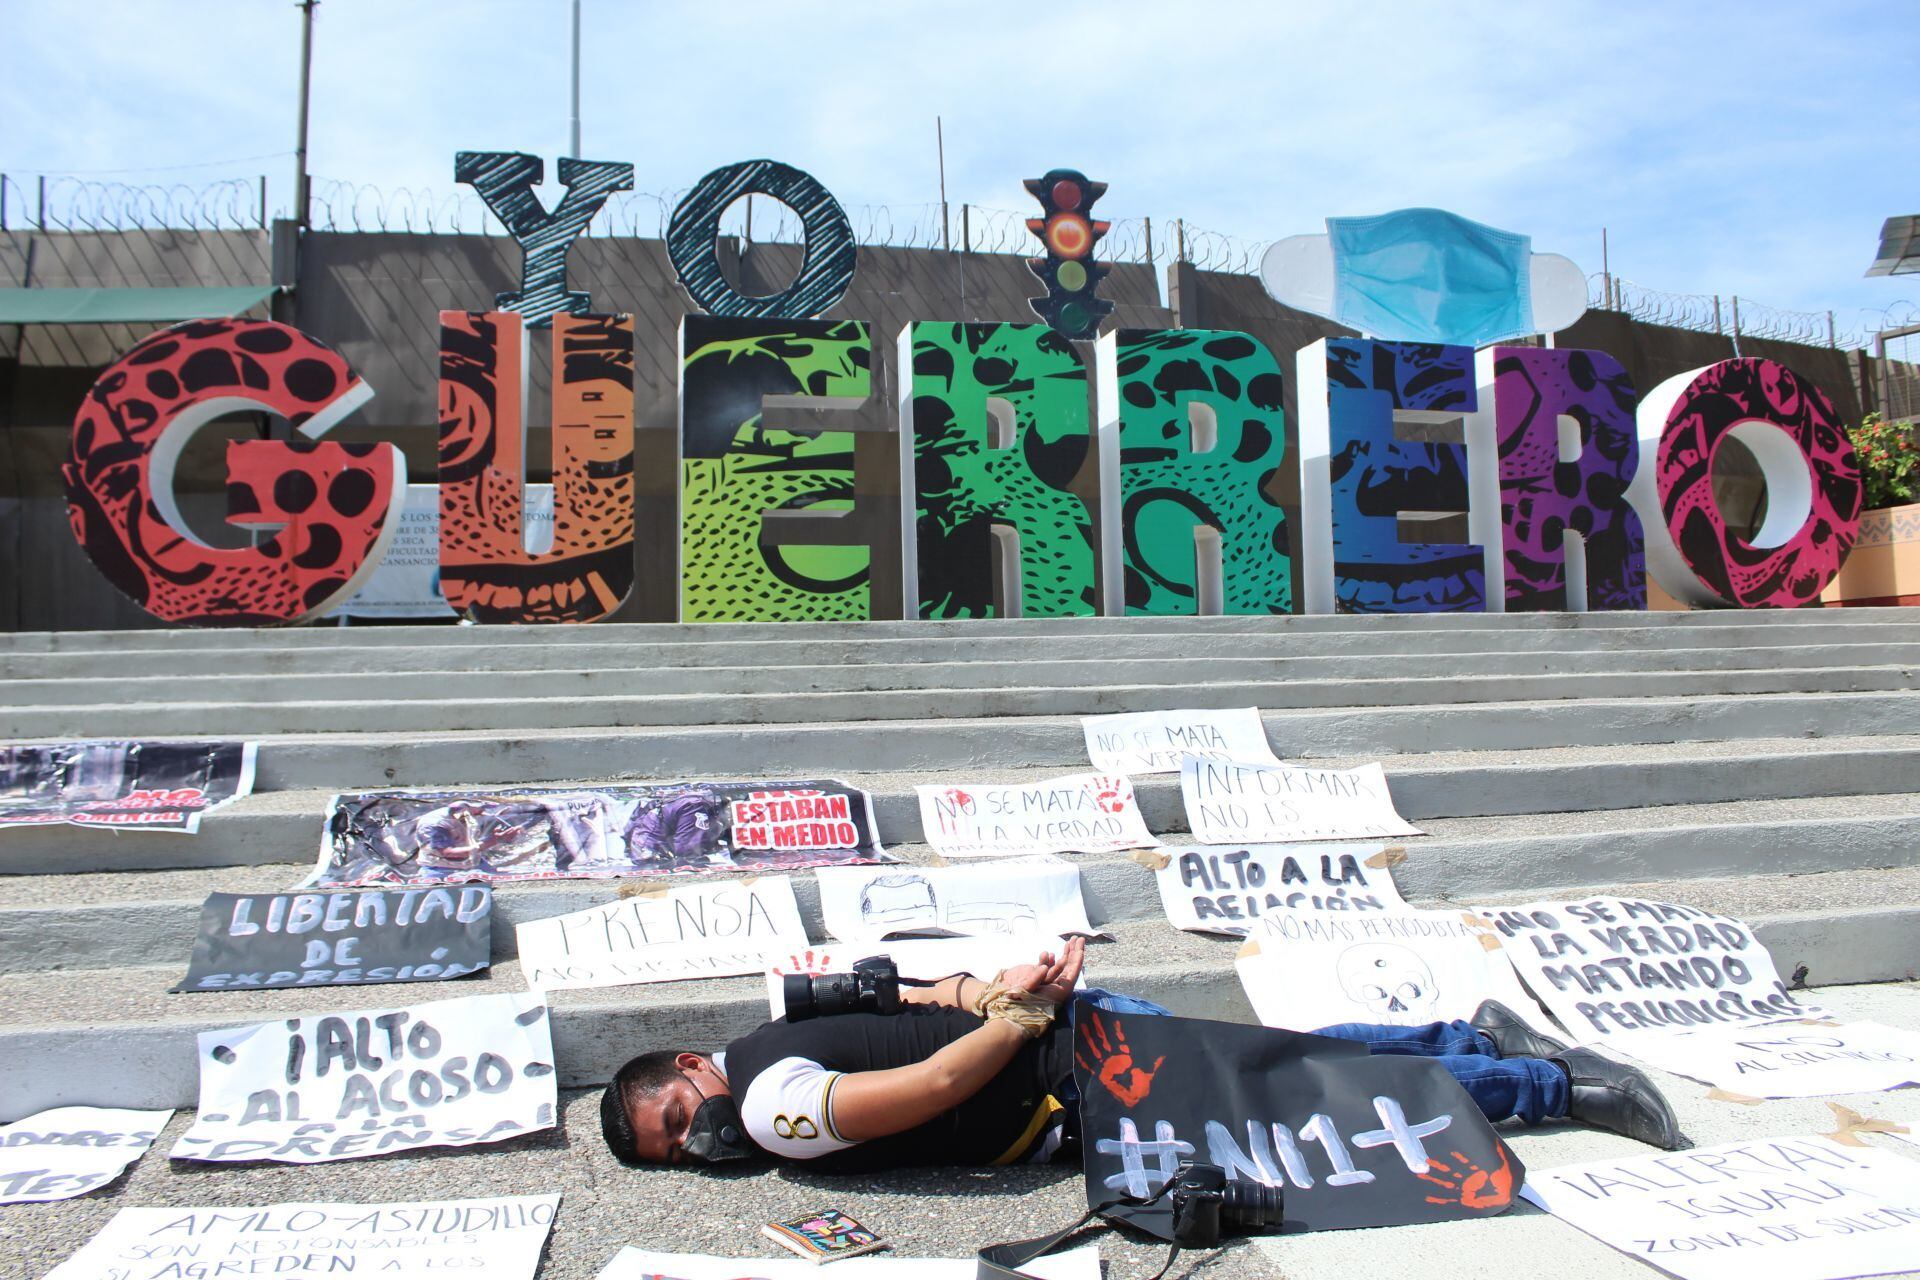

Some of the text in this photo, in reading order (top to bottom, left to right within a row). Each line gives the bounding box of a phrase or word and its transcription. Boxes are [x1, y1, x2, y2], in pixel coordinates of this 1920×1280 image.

[455, 151, 857, 328] YO
[61, 310, 1862, 628] GUERRERO
[1164, 724, 1228, 750] MATA
[1195, 761, 1377, 799] INFORMAR
[736, 796, 847, 824] ESTABAN
[935, 789, 1099, 821] NO SE MATA
[1200, 803, 1250, 828] NO
[736, 822, 857, 847] EN MEDIO
[1024, 816, 1124, 842] VERDAD
[1179, 850, 1369, 892] ALTO A LA
[228, 887, 493, 937] LIBERTAD
[559, 891, 778, 955] PRENSA
[1264, 913, 1301, 941] NO
[1565, 900, 1617, 925] SE
[301, 936, 362, 969] DE
[1530, 922, 1752, 959] LA VERDAD
[198, 946, 491, 988] EXPRESIÓN
[1541, 954, 1752, 995] MATANDO
[286, 1010, 443, 1085] ¡ALTO
[237, 1051, 514, 1127] AL ACOSO
[1552, 1140, 1870, 1201] ¡ALERTA!
[1657, 1179, 1878, 1219] IGUALA
[117, 1244, 201, 1261] SON
[1633, 1230, 1764, 1253] ZONA
[1758, 1223, 1822, 1243] DE
[149, 1255, 357, 1280] AGREDEN
[424, 1256, 487, 1270] LOS
